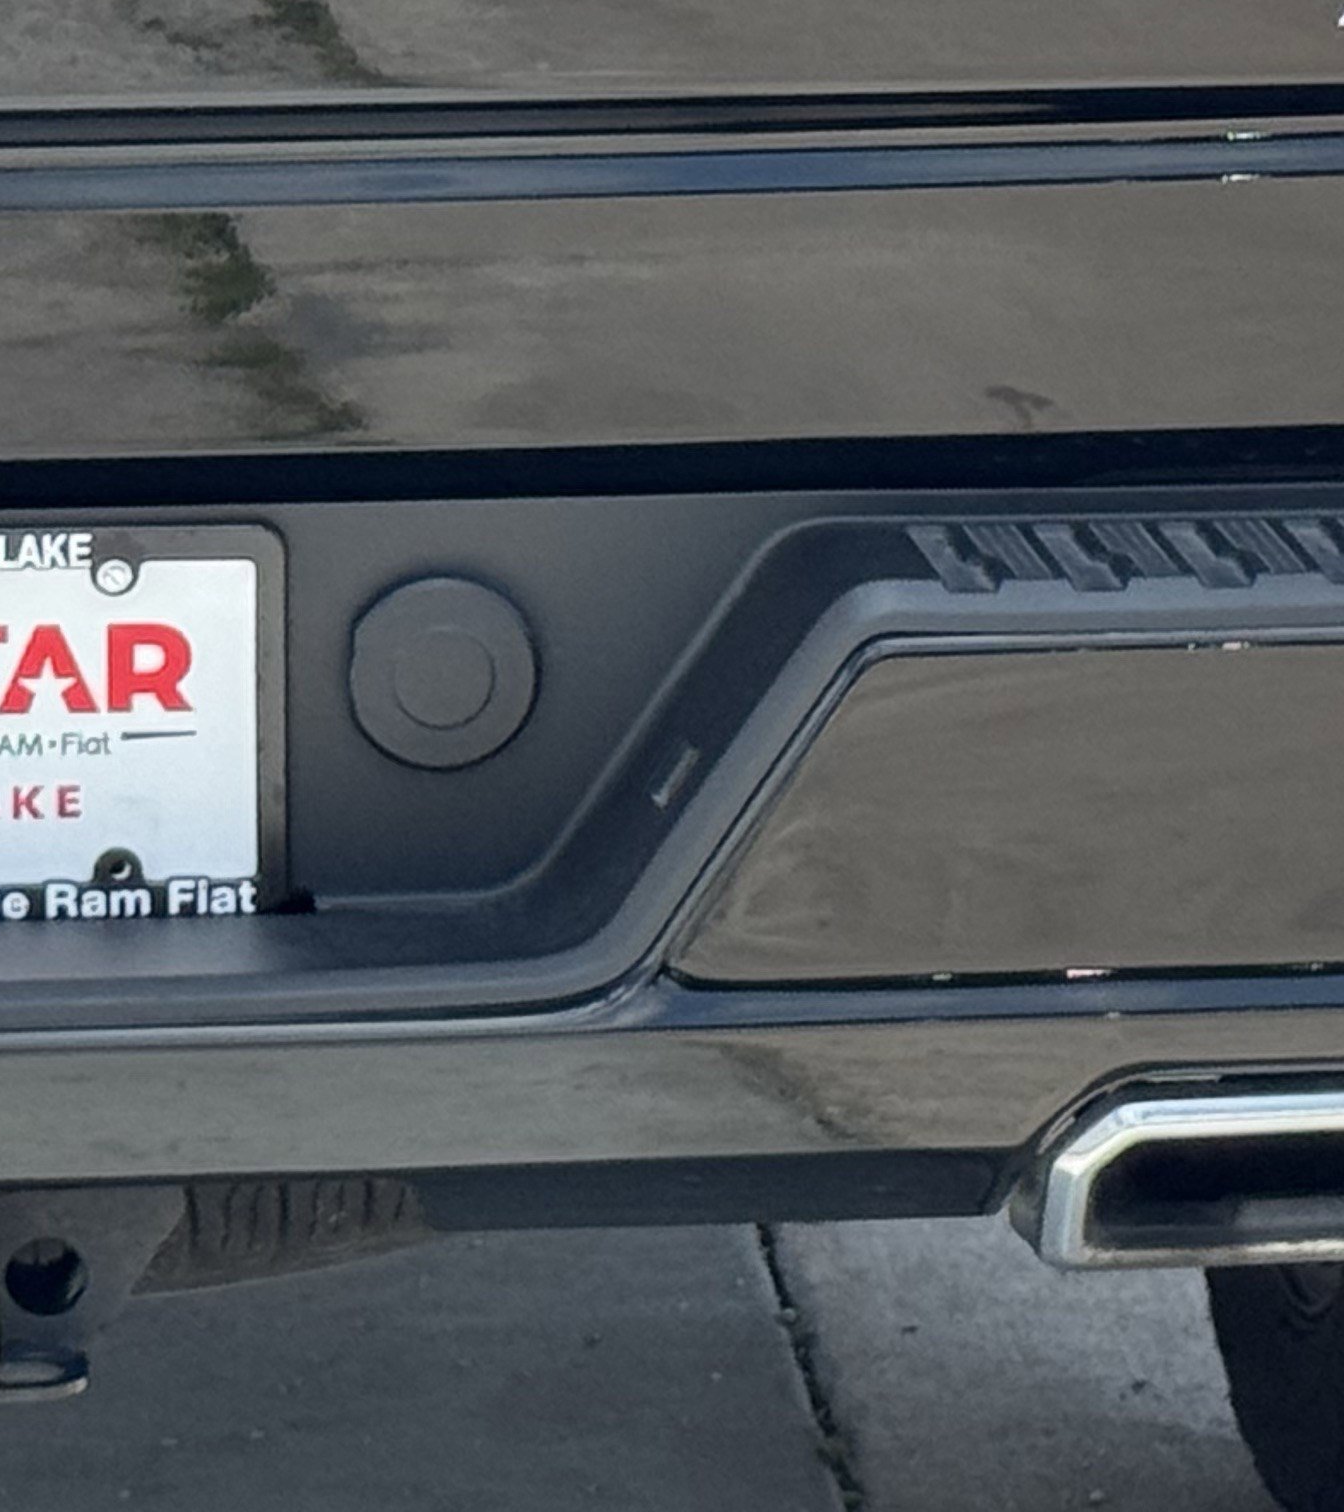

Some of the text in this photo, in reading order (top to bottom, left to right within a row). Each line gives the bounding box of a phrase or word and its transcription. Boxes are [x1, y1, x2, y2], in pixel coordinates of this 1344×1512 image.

[60, 732, 112, 755] Fiat
[44, 881, 152, 920] Ram
[167, 878, 257, 917] Fiat
